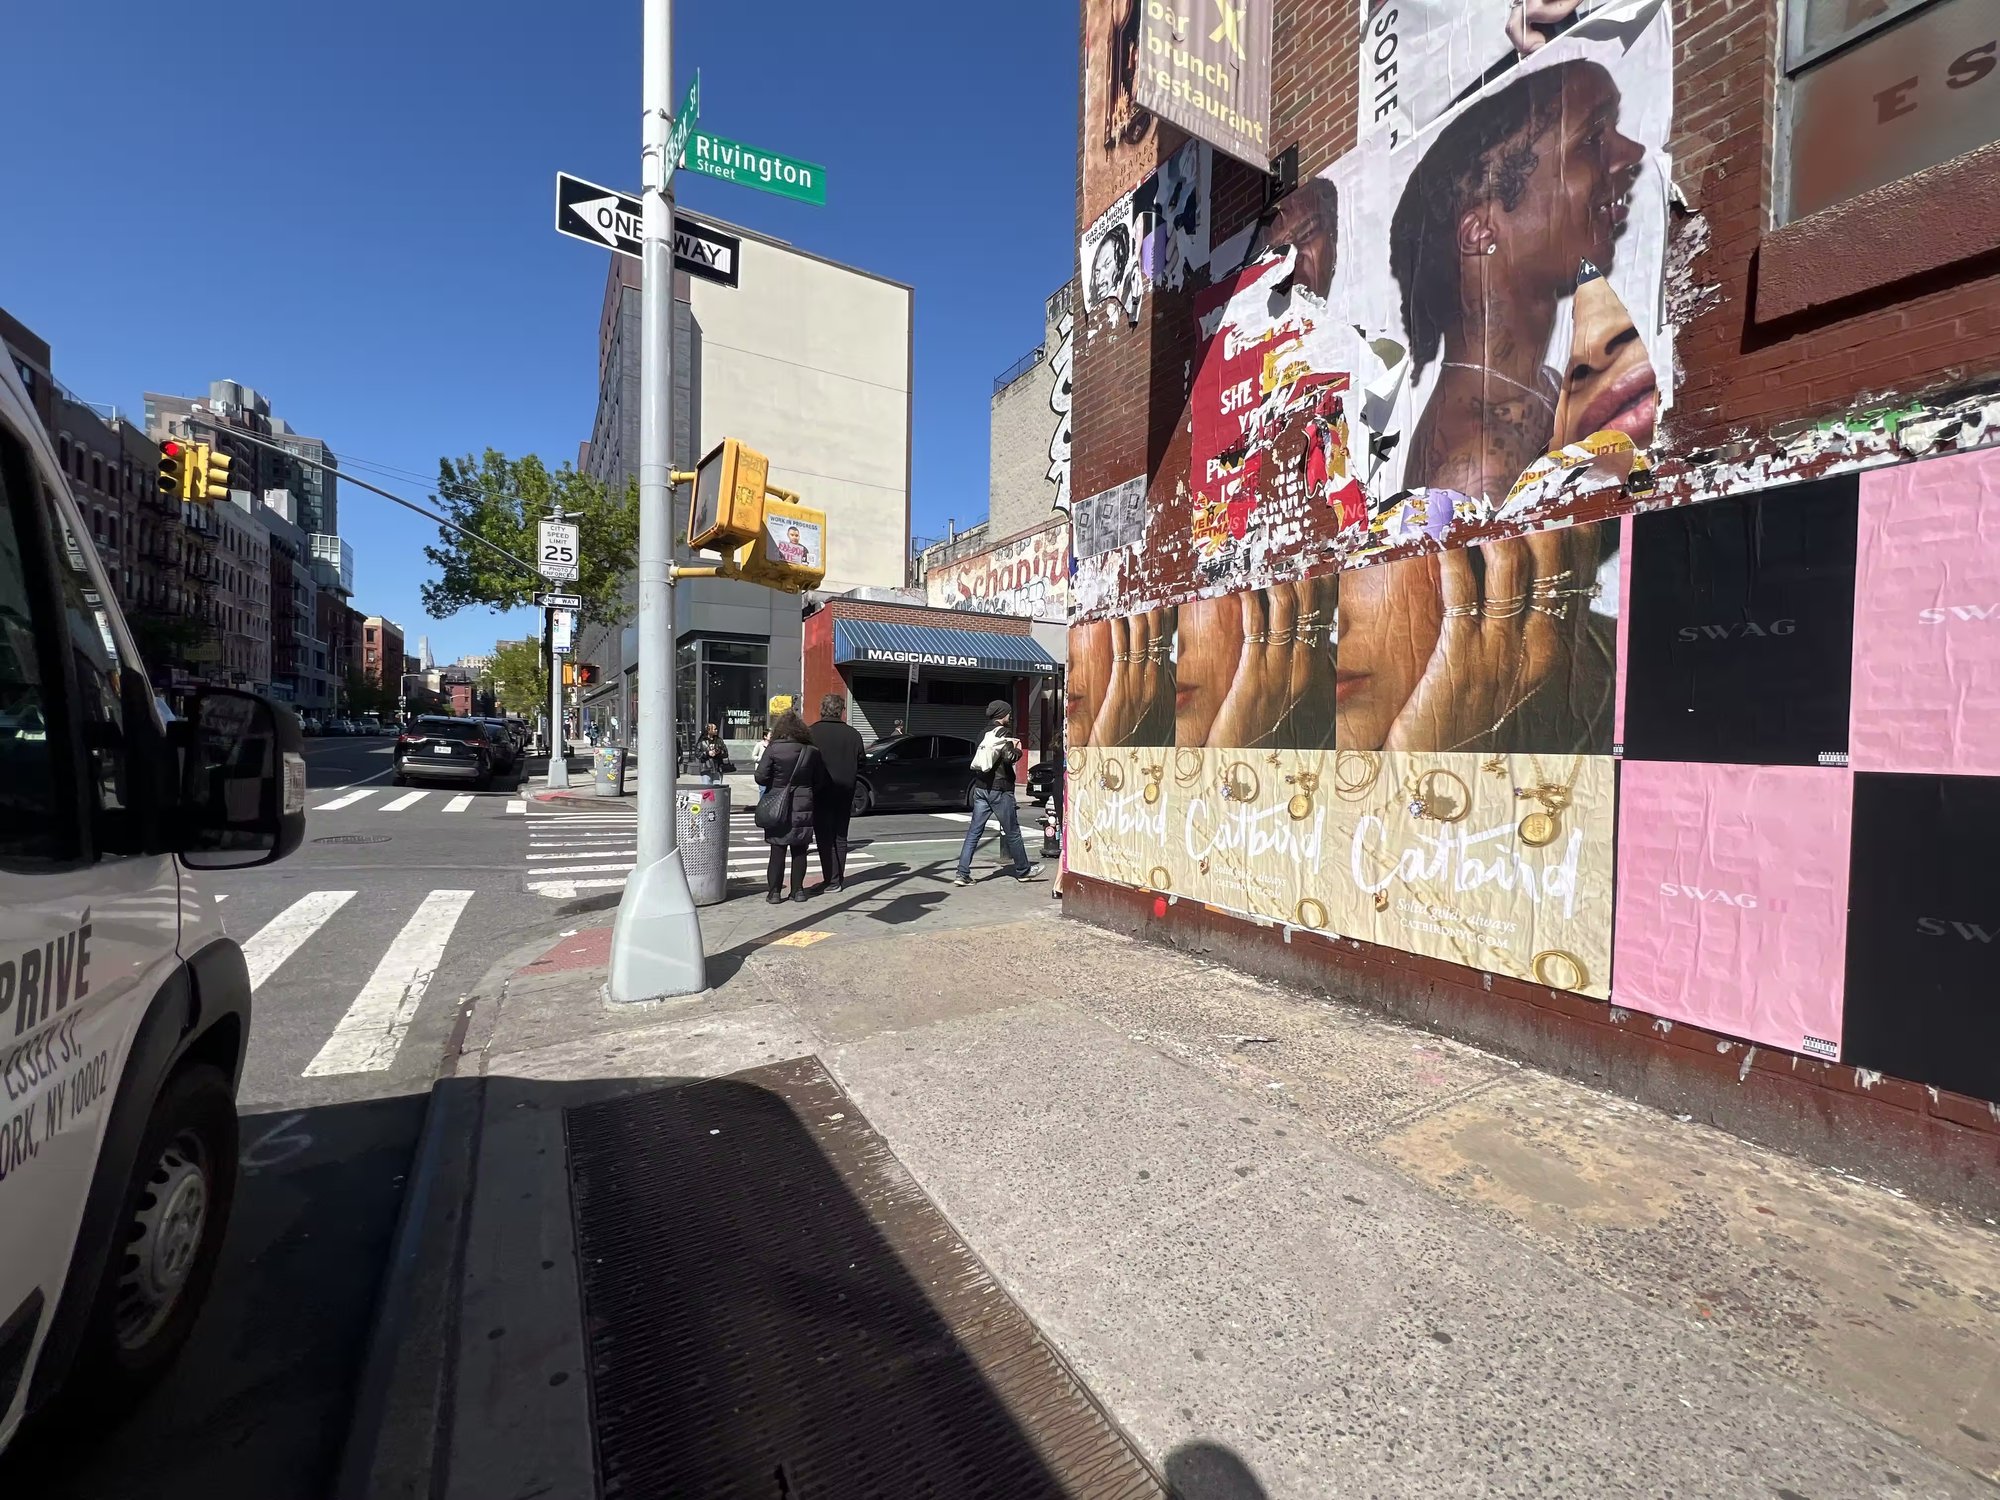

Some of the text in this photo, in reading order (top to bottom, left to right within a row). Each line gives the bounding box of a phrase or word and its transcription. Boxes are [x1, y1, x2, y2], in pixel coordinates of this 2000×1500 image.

[1147, 0, 1190, 34] bar
[1147, 28, 1229, 93] brunch
[1374, 8, 1399, 123] SOFIE
[689, 84, 696, 112] St
[1148, 63, 1263, 144] restaurant
[696, 135, 812, 188] Rivington
[696, 158, 736, 181] Street
[597, 206, 722, 266] ONE WAY
[1085, 195, 1133, 242] GAS IS HIGH AS
[1088, 208, 1130, 247] SNOOP DOGG
[1220, 377, 1253, 416] SHE
[547, 531, 569, 539] SPEED
[770, 516, 785, 524] WORK
[793, 519, 818, 531] PROGRESS
[544, 545, 573, 562] 25
[542, 570, 575, 578] ENFORCED
[1678, 618, 1796, 642] SWAG
[1918, 603, 2000, 625] SW
[867, 649, 978, 667] MAGICIAN BAR
[1074, 788, 1168, 848] Catbird
[1184, 798, 1326, 875] Catbird
[1351, 815, 1583, 920] Catbird
[1396, 898, 1428, 914] Solid
[1466, 910, 1517, 933] always
[1660, 883, 1758, 909] SWAG
[4, 1008, 83, 1101] ESSEX ST,
[46, 1080, 66, 1142] NY
[71, 1050, 107, 1120] 10002
